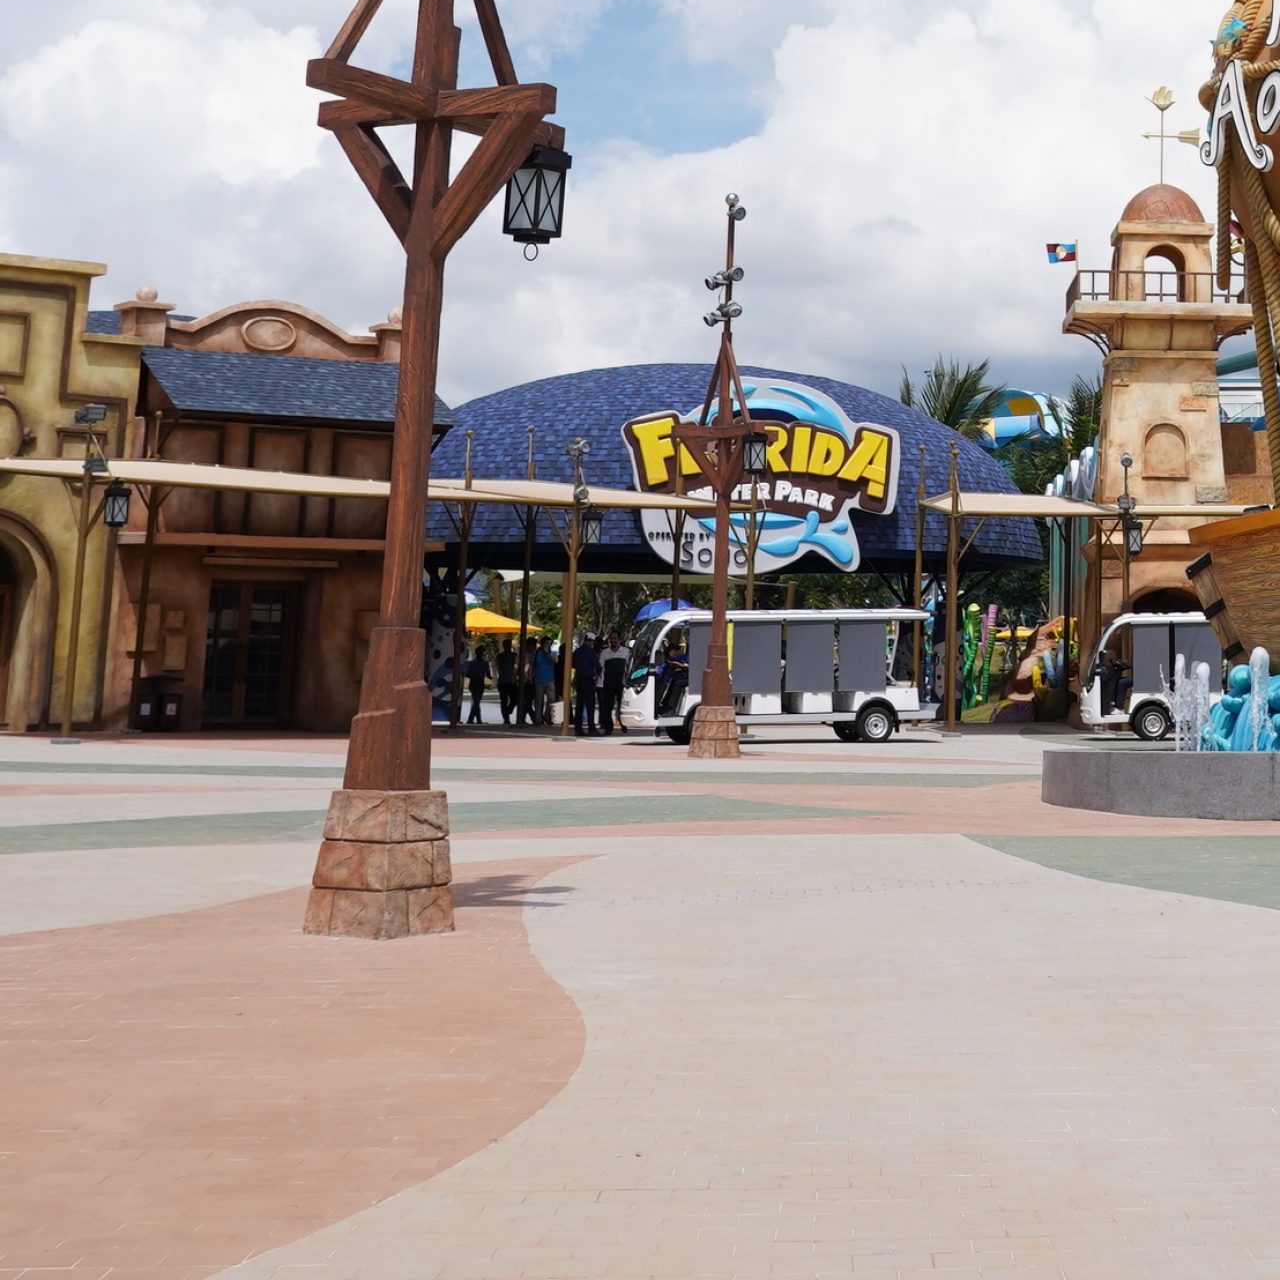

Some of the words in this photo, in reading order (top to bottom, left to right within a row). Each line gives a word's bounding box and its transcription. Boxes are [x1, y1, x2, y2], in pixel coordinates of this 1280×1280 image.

[631, 417, 888, 499] FRIDA
[687, 482, 771, 501] WTER
[774, 480, 835, 512] PARK
[648, 531, 695, 541] OPERED
[699, 532, 711, 541] BY
[681, 541, 748, 567] SOO
